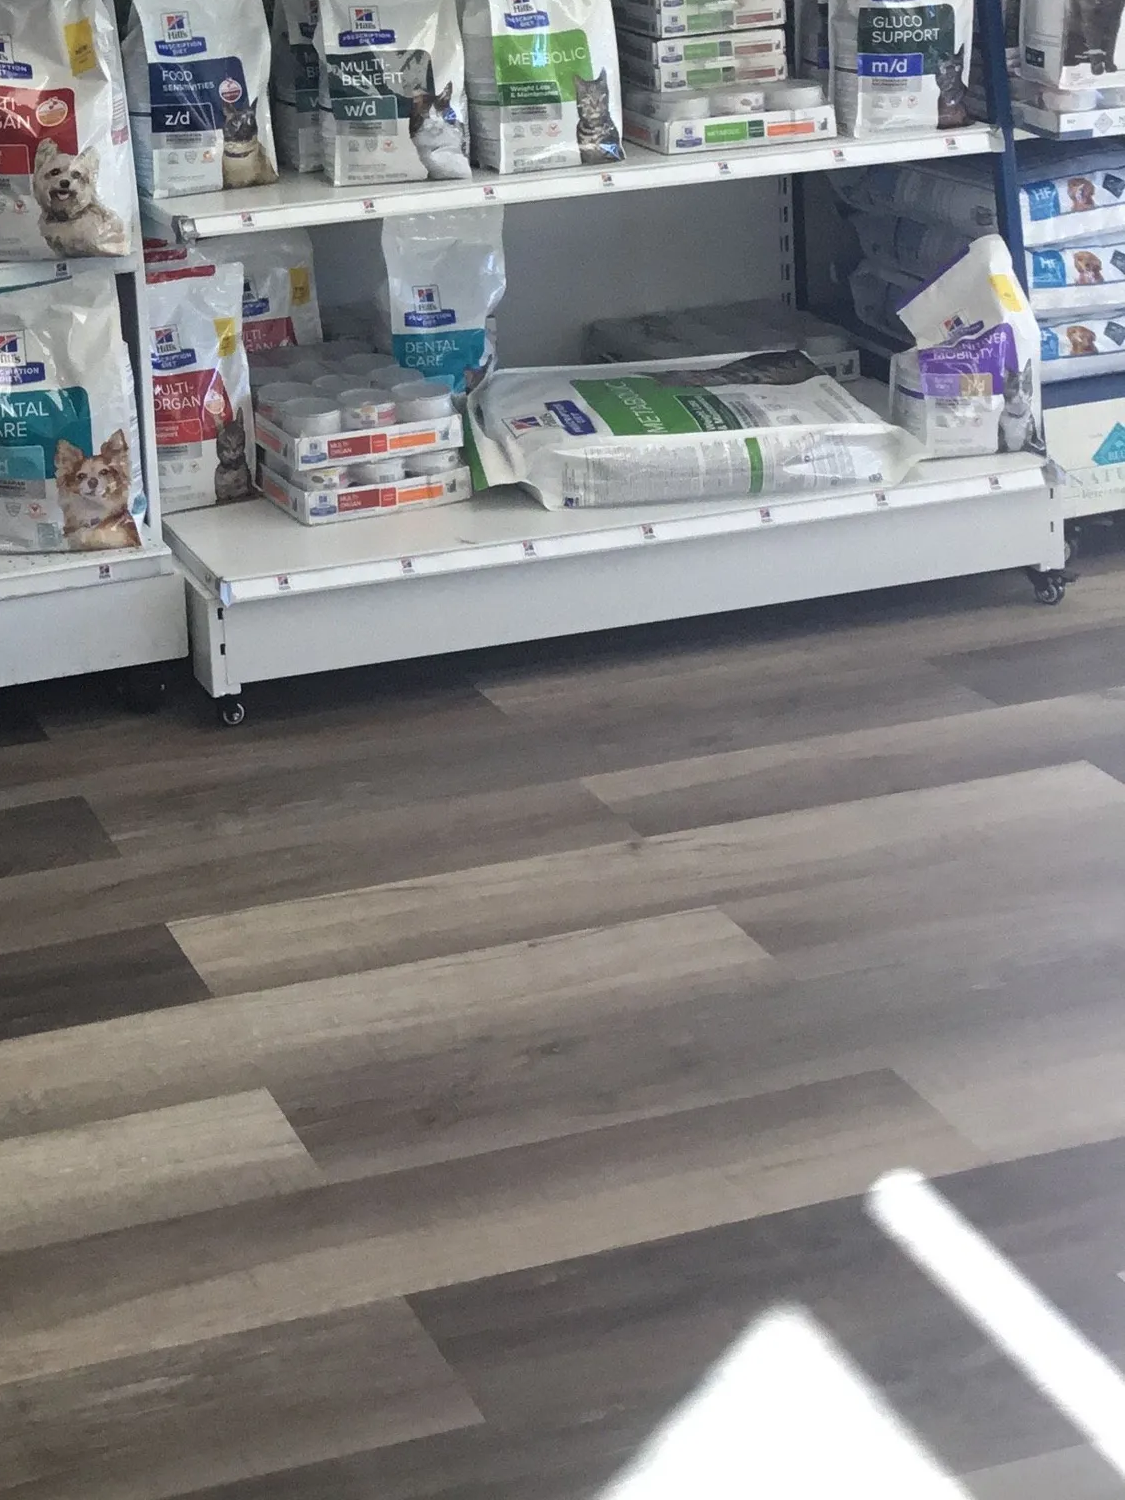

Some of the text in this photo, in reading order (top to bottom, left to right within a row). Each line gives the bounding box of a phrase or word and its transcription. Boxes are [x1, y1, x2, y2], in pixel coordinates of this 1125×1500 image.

[872, 15, 923, 29] GLUCO
[168, 30, 188, 39] Hill's
[872, 28, 940, 44] SUPPORT
[341, 61, 389, 74] MULTI-
[871, 57, 908, 74] m/d
[162, 70, 193, 82] FOOD
[342, 72, 404, 87] BENEFIT
[162, 81, 215, 92] SENSITIVITIES
[344, 101, 375, 117] w/d
[165, 111, 190, 125] z/d
[405, 339, 460, 353] DENTAL
[405, 353, 444, 367] CARE
[153, 396, 201, 411] ORGAN
